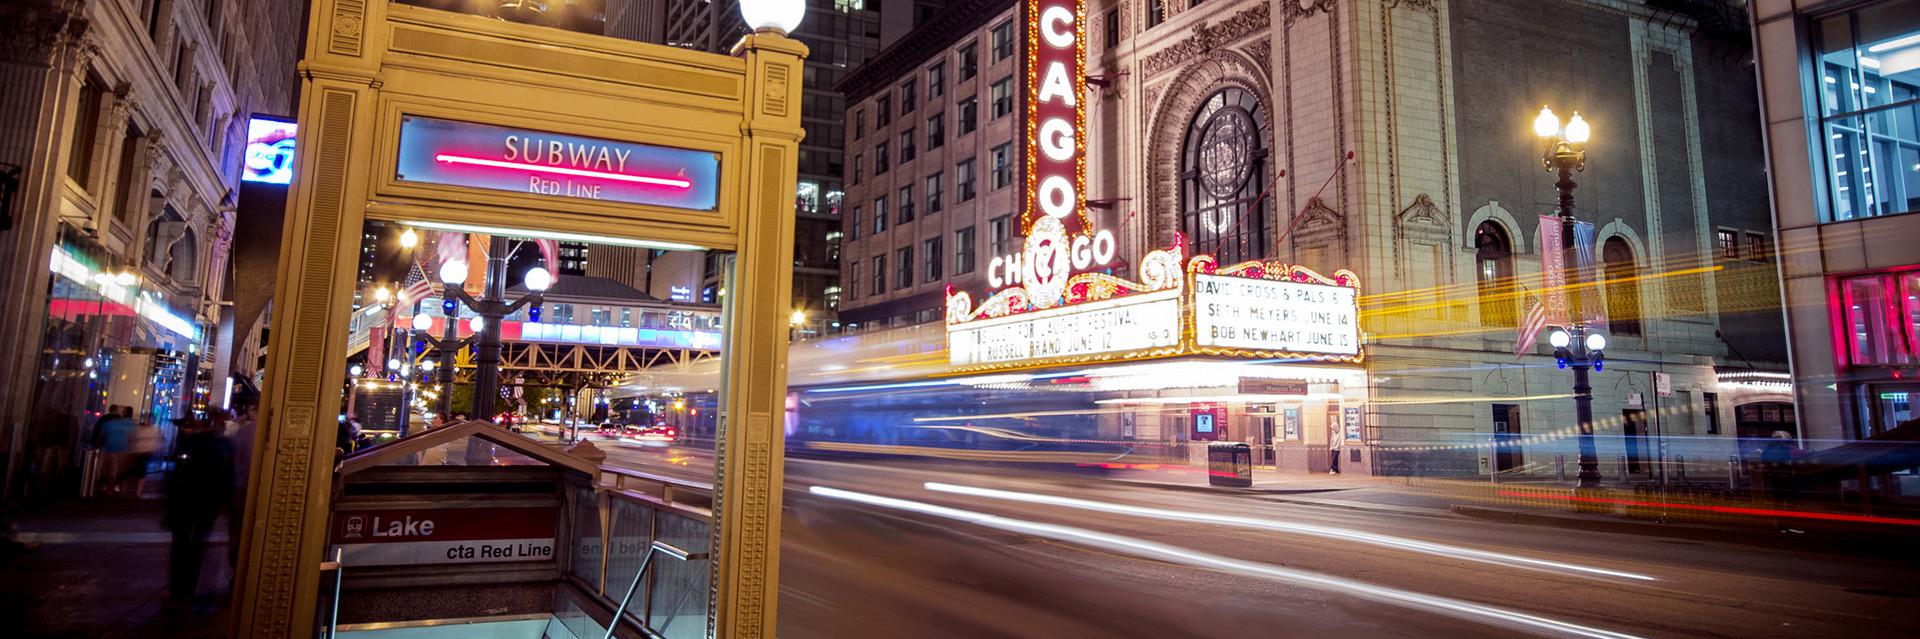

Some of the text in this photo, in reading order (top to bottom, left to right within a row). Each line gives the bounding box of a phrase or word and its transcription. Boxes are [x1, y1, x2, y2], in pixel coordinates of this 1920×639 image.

[503, 135, 631, 172] SUBWAY
[1553, 222, 1563, 269] Museum
[1196, 280, 1231, 296] DAVID
[1240, 284, 1277, 299] CROSS
[1297, 289, 1325, 303] PALS
[1088, 309, 1138, 330] FESTIVAL
[1208, 303, 1348, 325] SETH MEYERS JUNE 14
[987, 332, 1112, 361] RUSSELL BRAND JUNE 12
[1211, 324, 1348, 347] BOB NEWHART JUNE 15
[372, 515, 435, 537] Lake
[447, 543, 551, 560] cta Red Line
